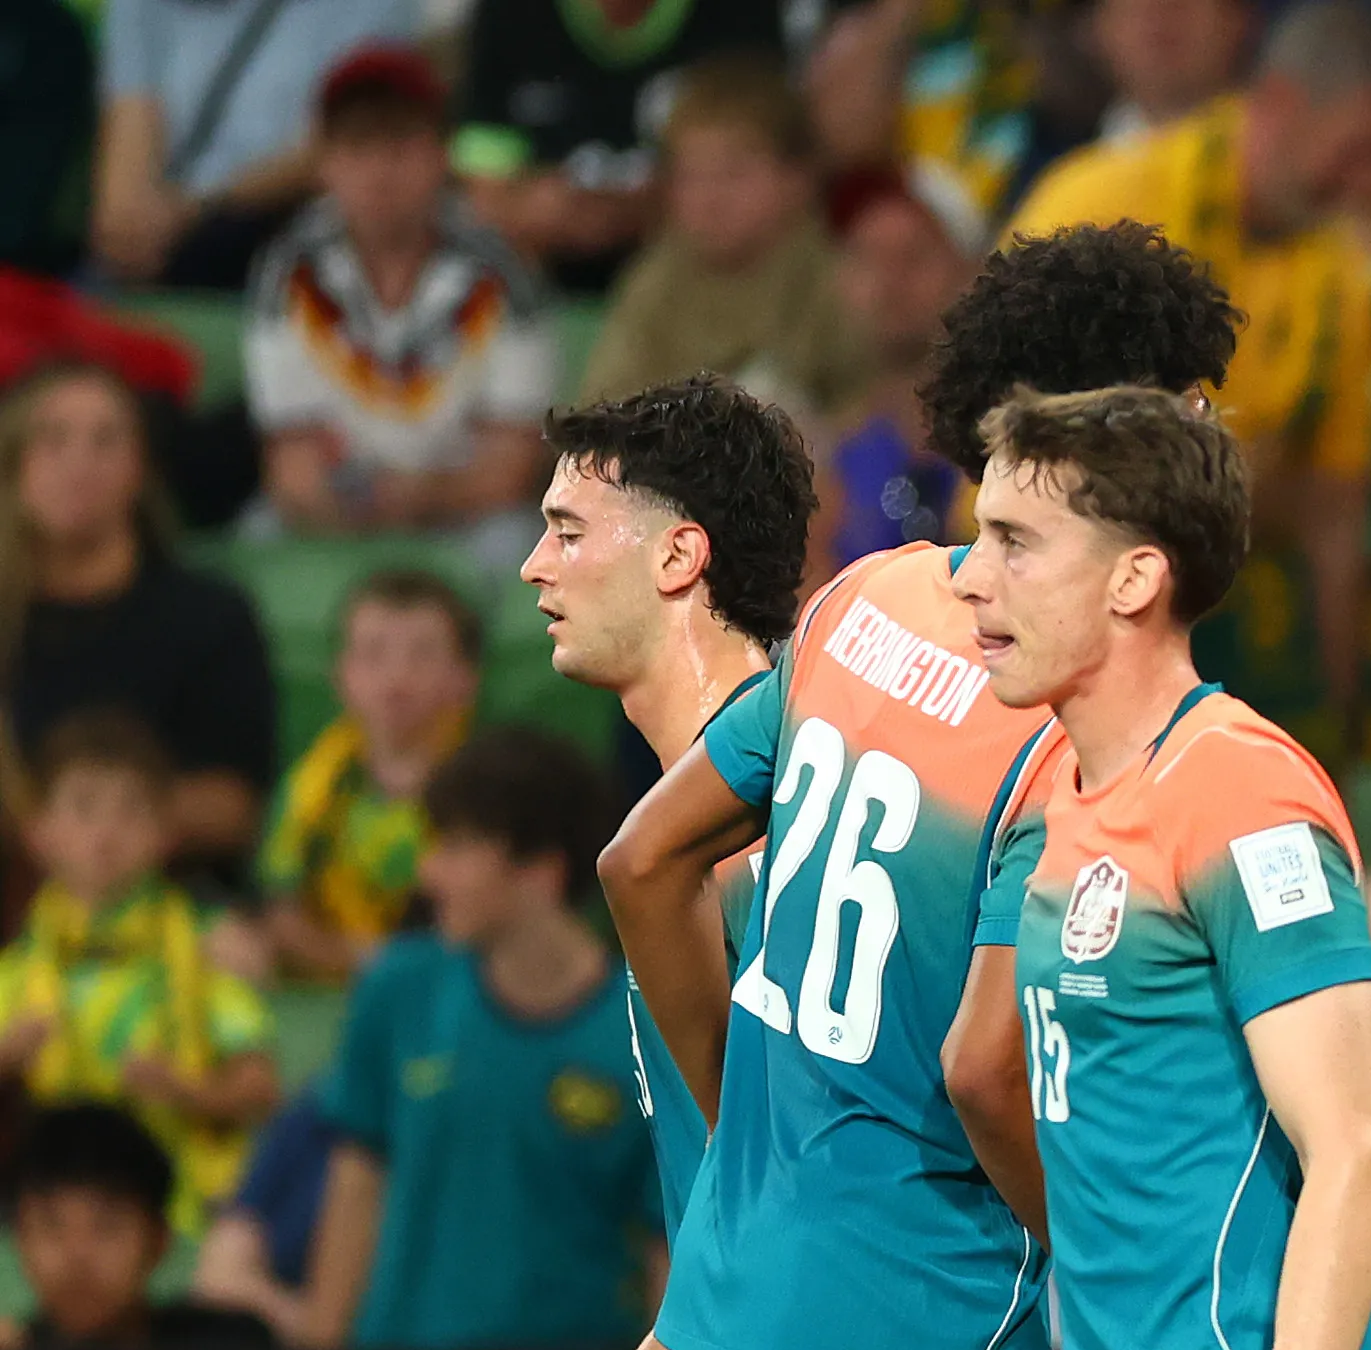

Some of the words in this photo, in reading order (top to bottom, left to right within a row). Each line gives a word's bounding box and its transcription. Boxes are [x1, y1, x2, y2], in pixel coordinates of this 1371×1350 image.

[823, 596, 990, 727] HERRINGTON
[731, 716, 920, 1064] 26
[1024, 985, 1070, 1123] 15
